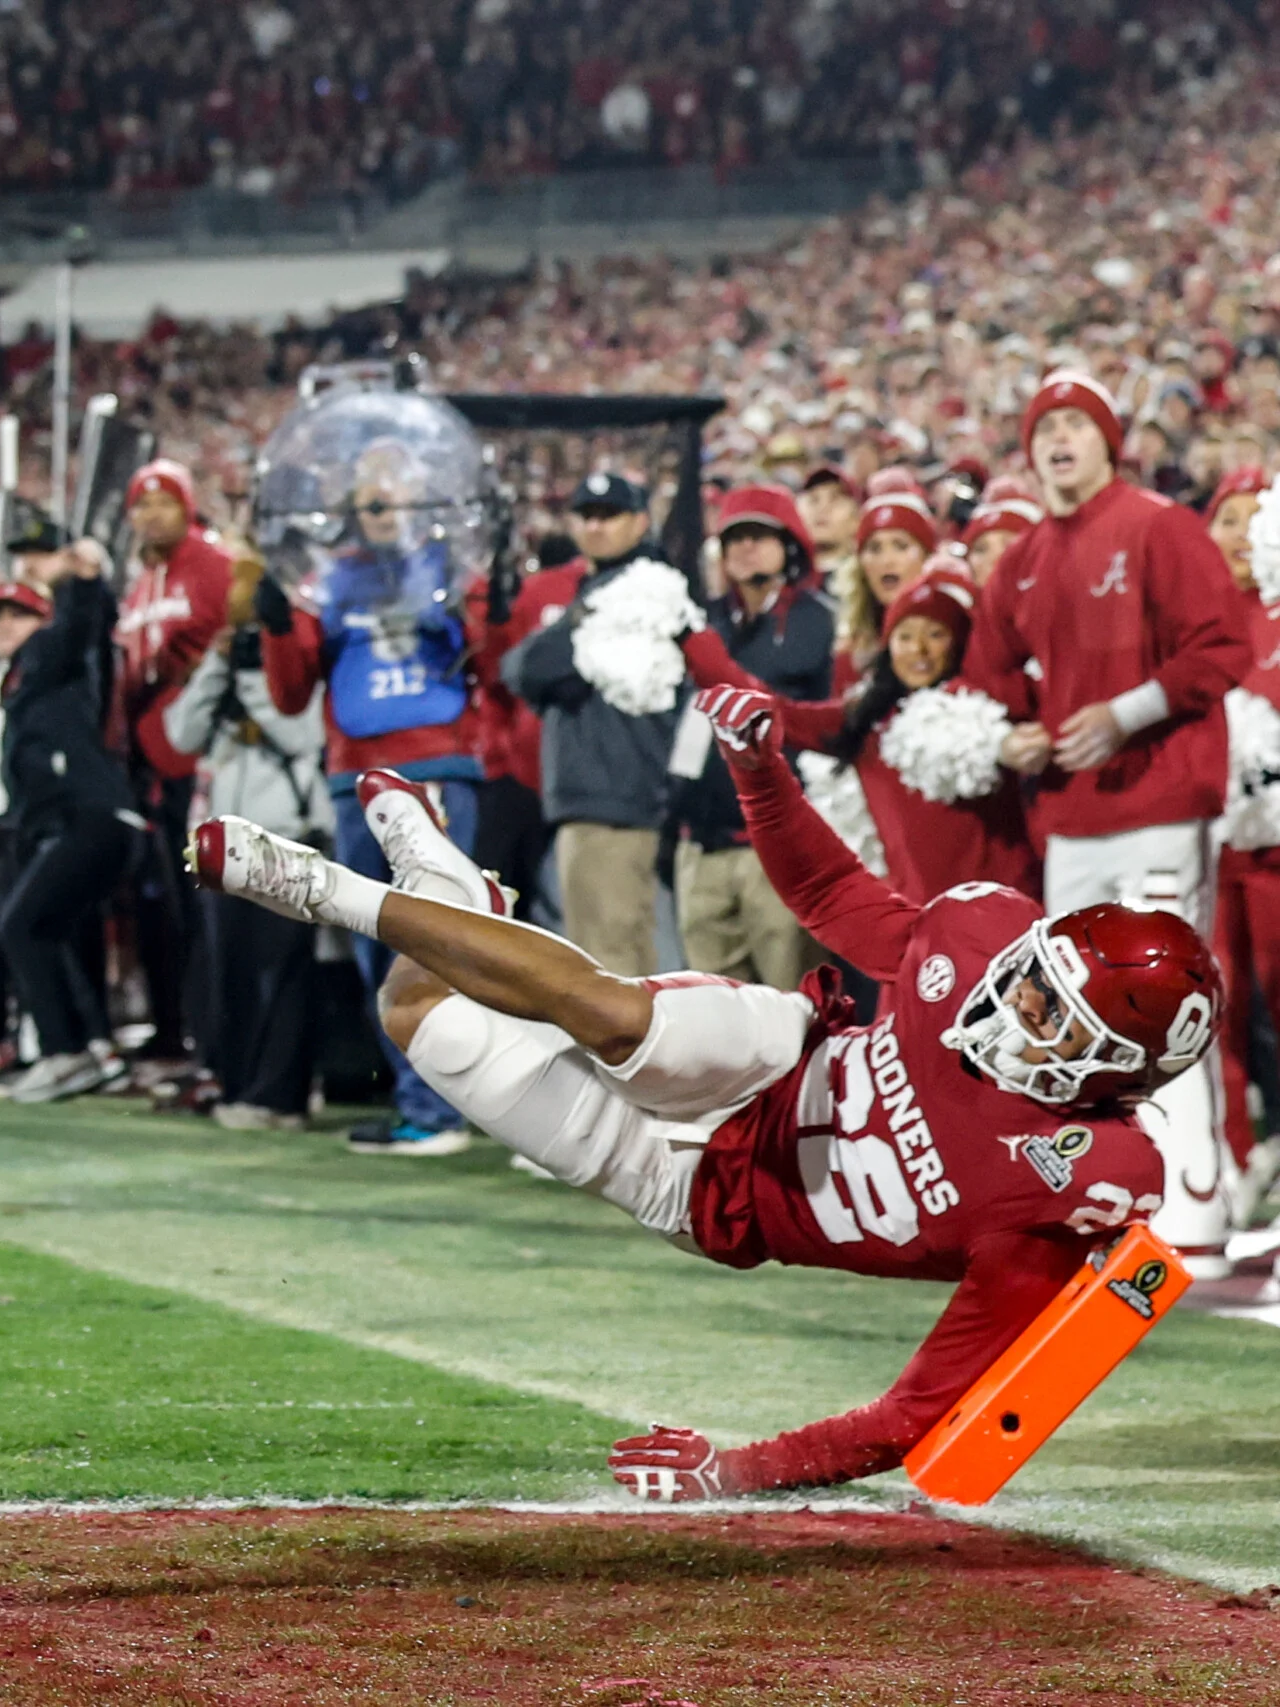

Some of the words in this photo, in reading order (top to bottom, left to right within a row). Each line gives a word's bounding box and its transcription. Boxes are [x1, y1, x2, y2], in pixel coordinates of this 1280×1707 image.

[1090, 550, 1128, 598] A
[369, 664, 427, 700] 212
[918, 956, 955, 1000] SEC
[1157, 991, 1211, 1074] OU
